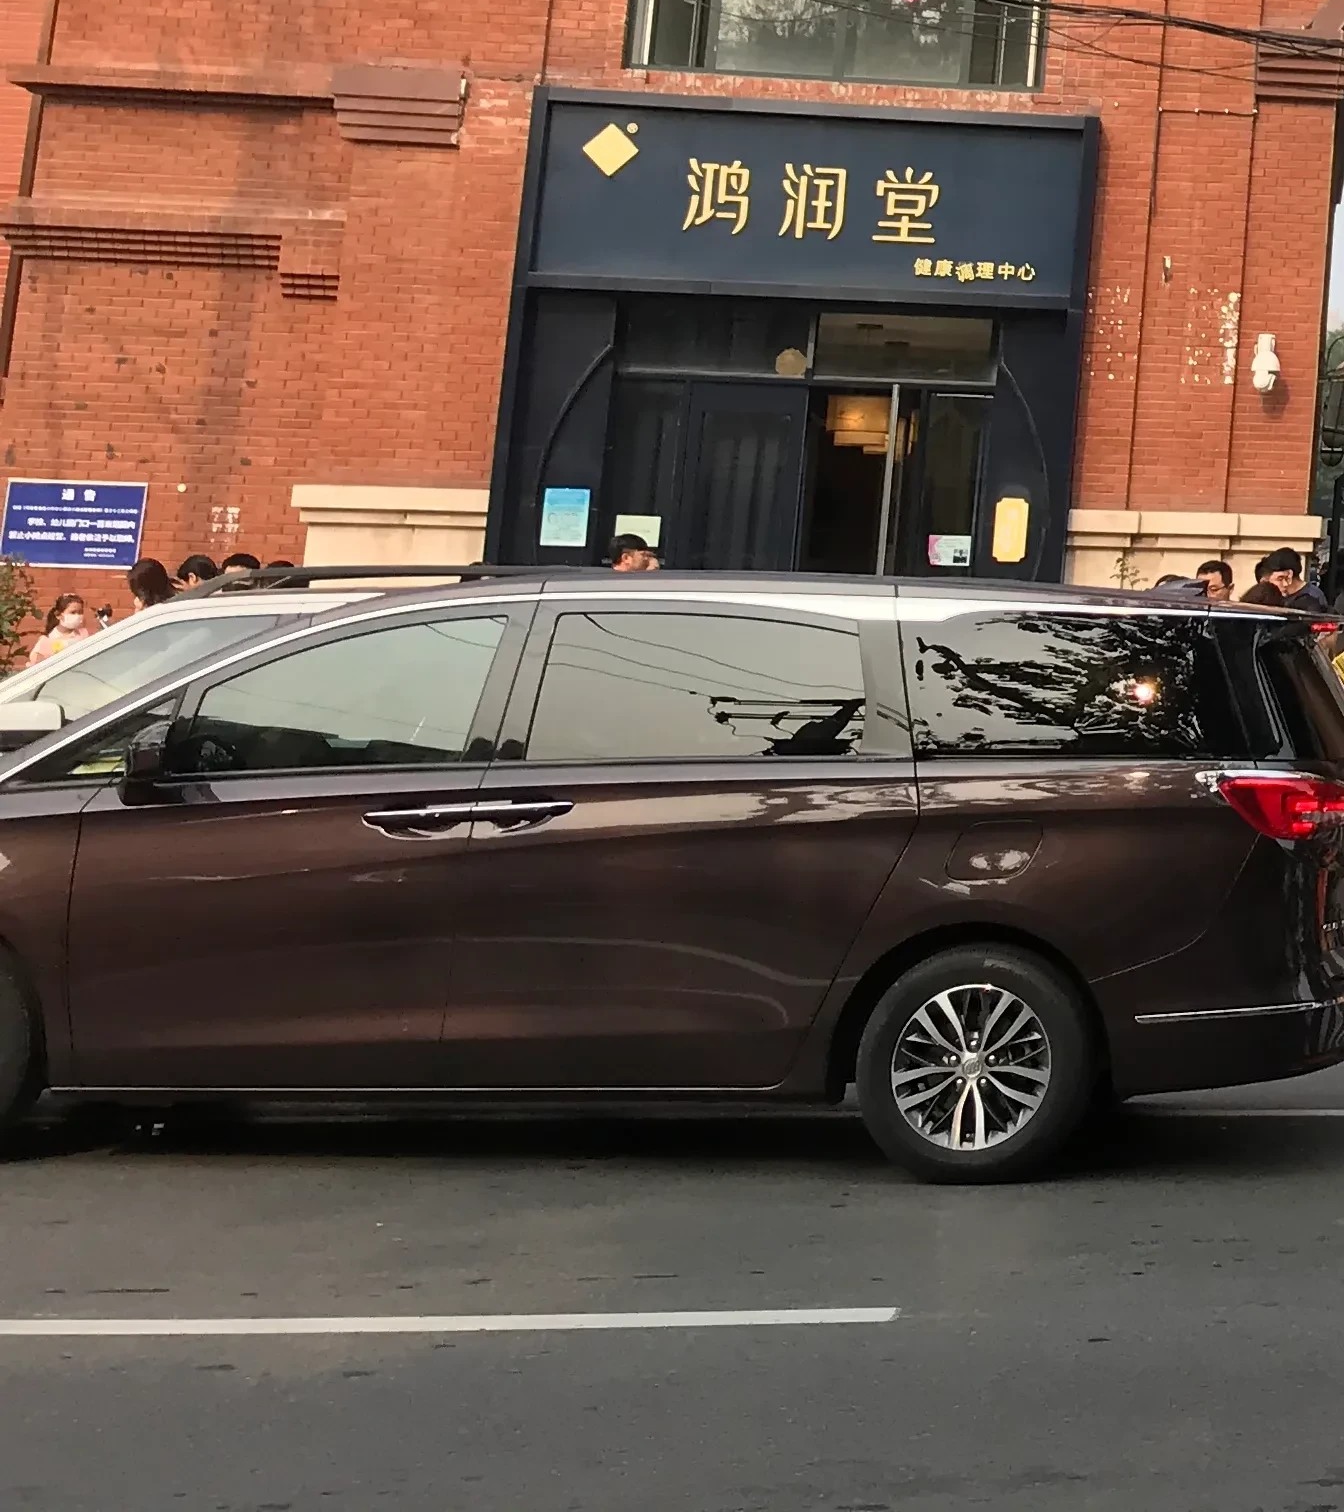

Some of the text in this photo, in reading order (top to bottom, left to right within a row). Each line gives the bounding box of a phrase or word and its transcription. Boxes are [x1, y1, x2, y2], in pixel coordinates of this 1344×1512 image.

[682, 157, 940, 244] 鸿润堂
[914, 257, 1036, 282] 健康调理中心
